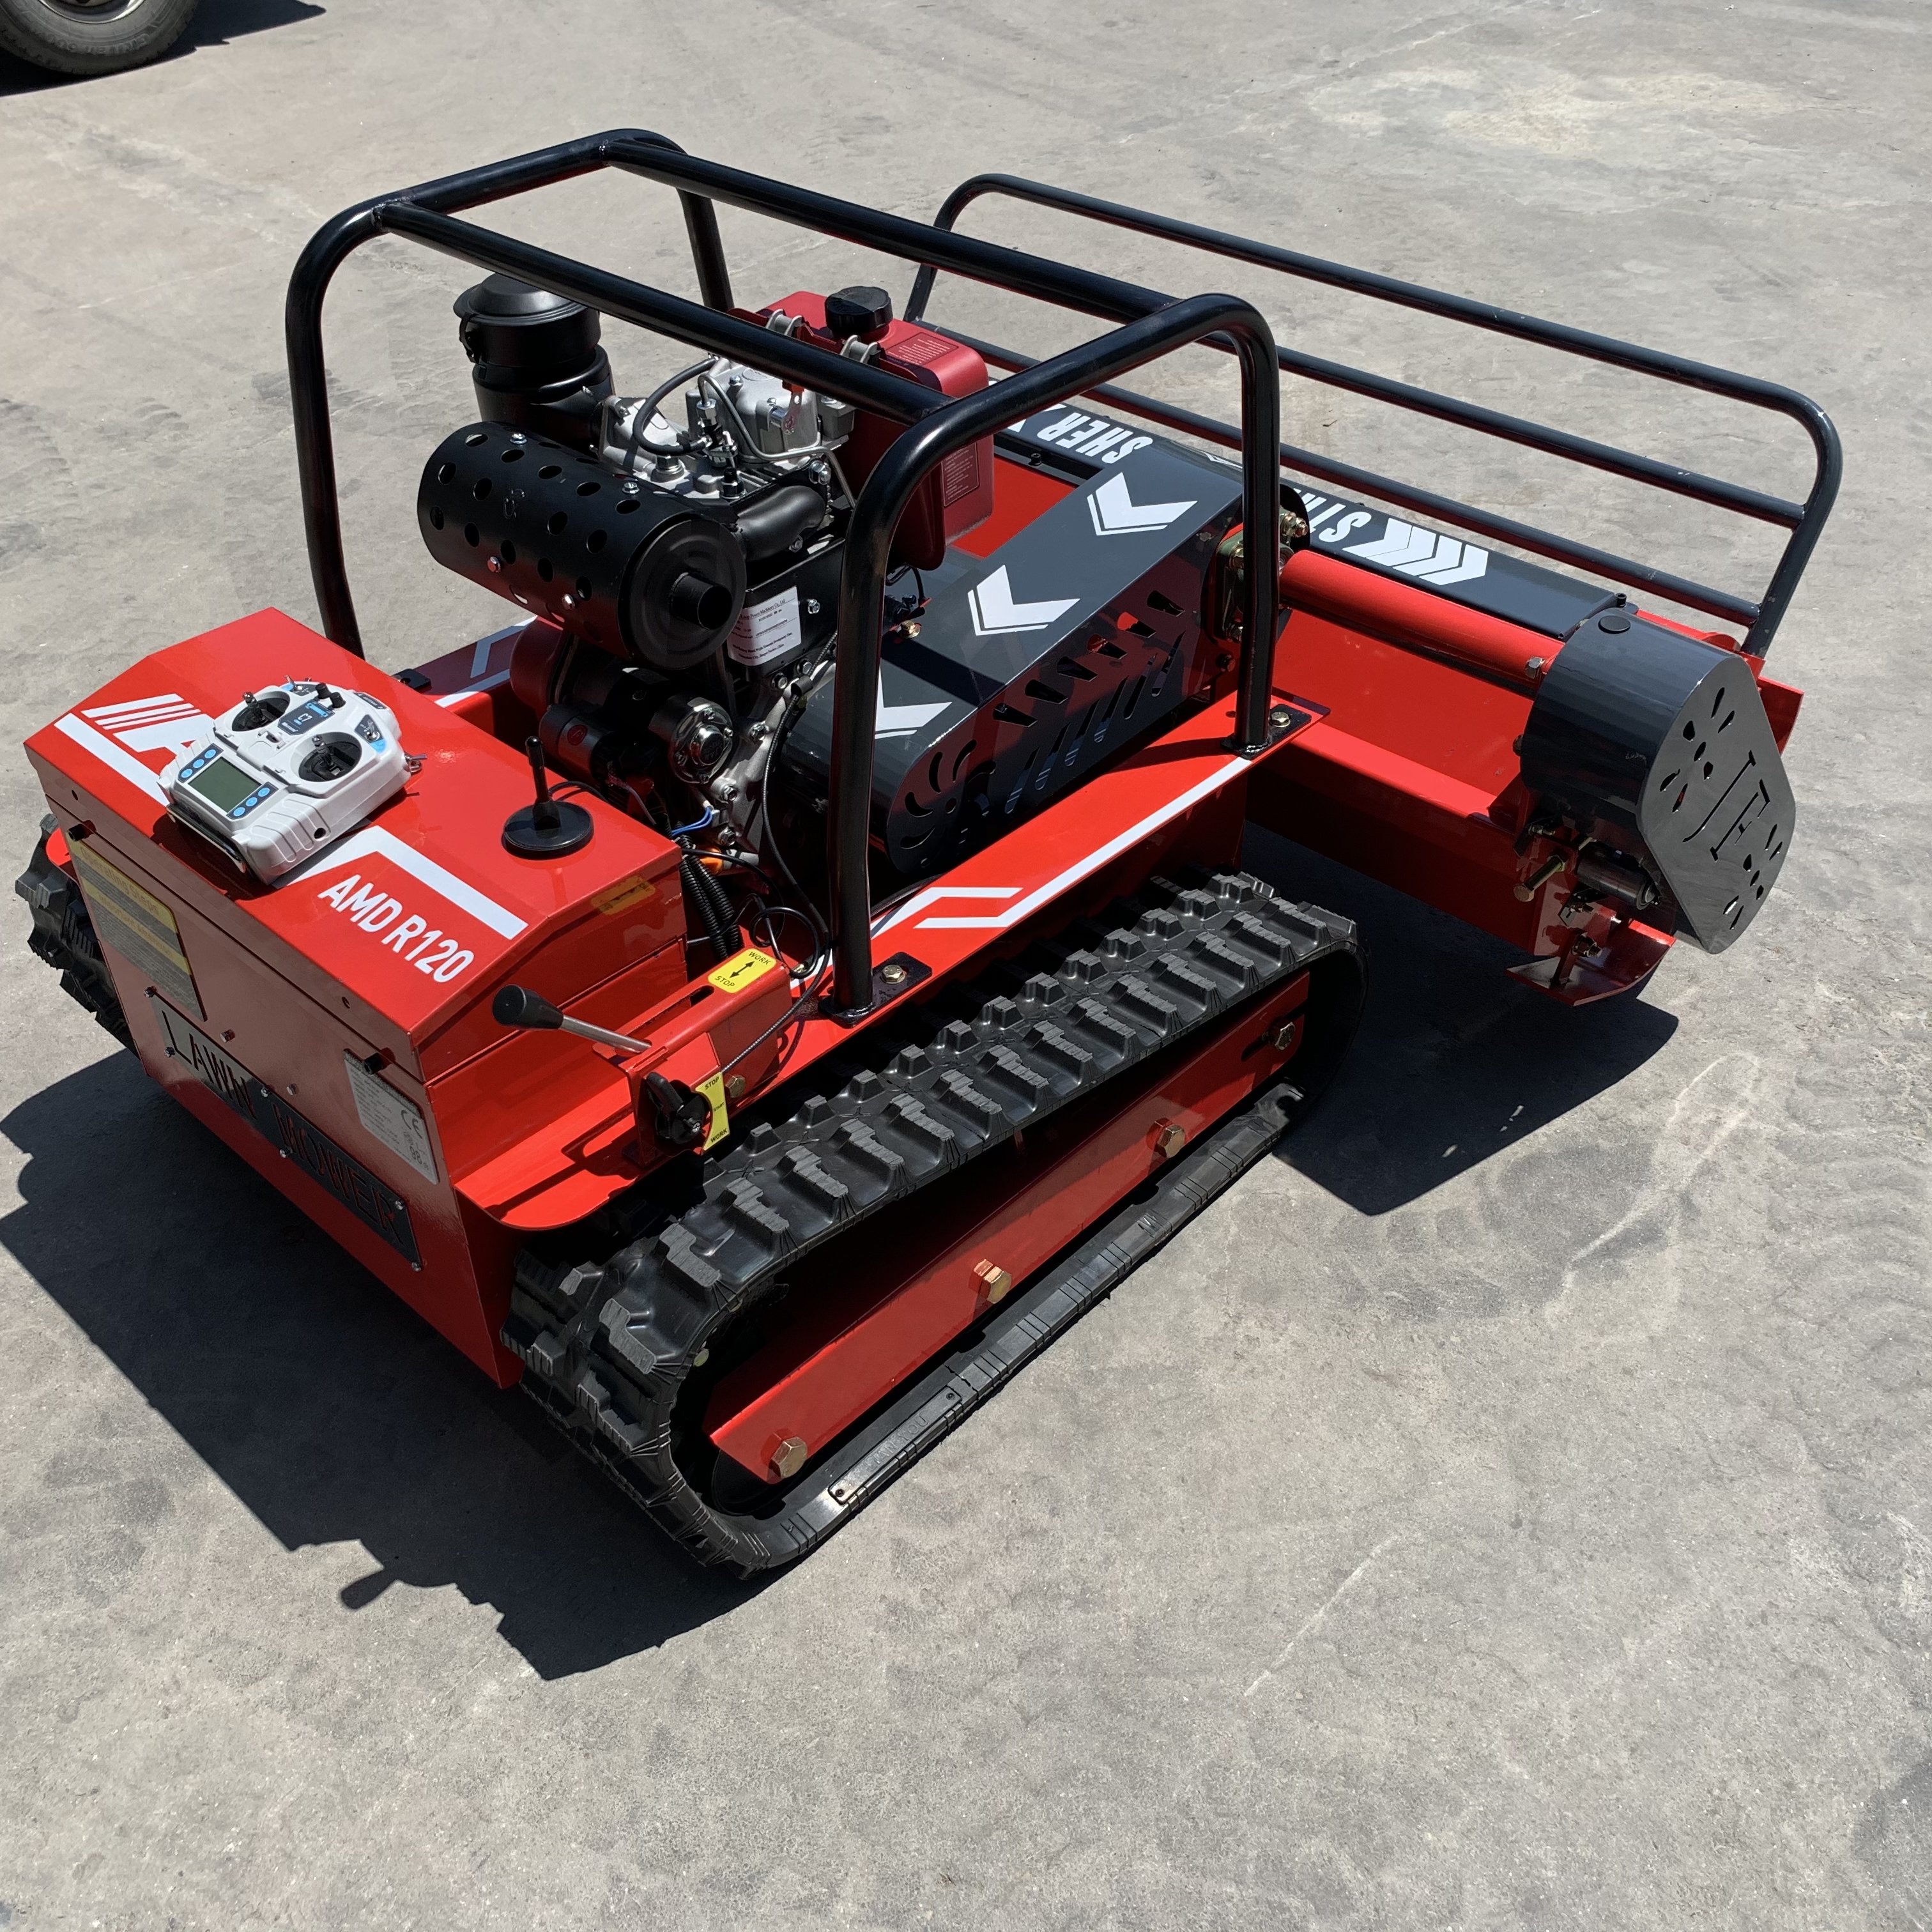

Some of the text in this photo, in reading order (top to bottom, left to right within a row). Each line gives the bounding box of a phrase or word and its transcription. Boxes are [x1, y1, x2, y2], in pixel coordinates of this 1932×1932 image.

[298, 713, 313, 723] C7
[318, 874, 474, 983] AMD R120
[749, 951, 772, 965] WORK
[714, 976, 735, 987] STOP
[705, 1076, 719, 1090] STOP
[162, 1010, 257, 1120] LAWN
[271, 1103, 405, 1246] MOWER
[710, 1128, 727, 1143] WORK
[896, 1413, 929, 1442] YOU
